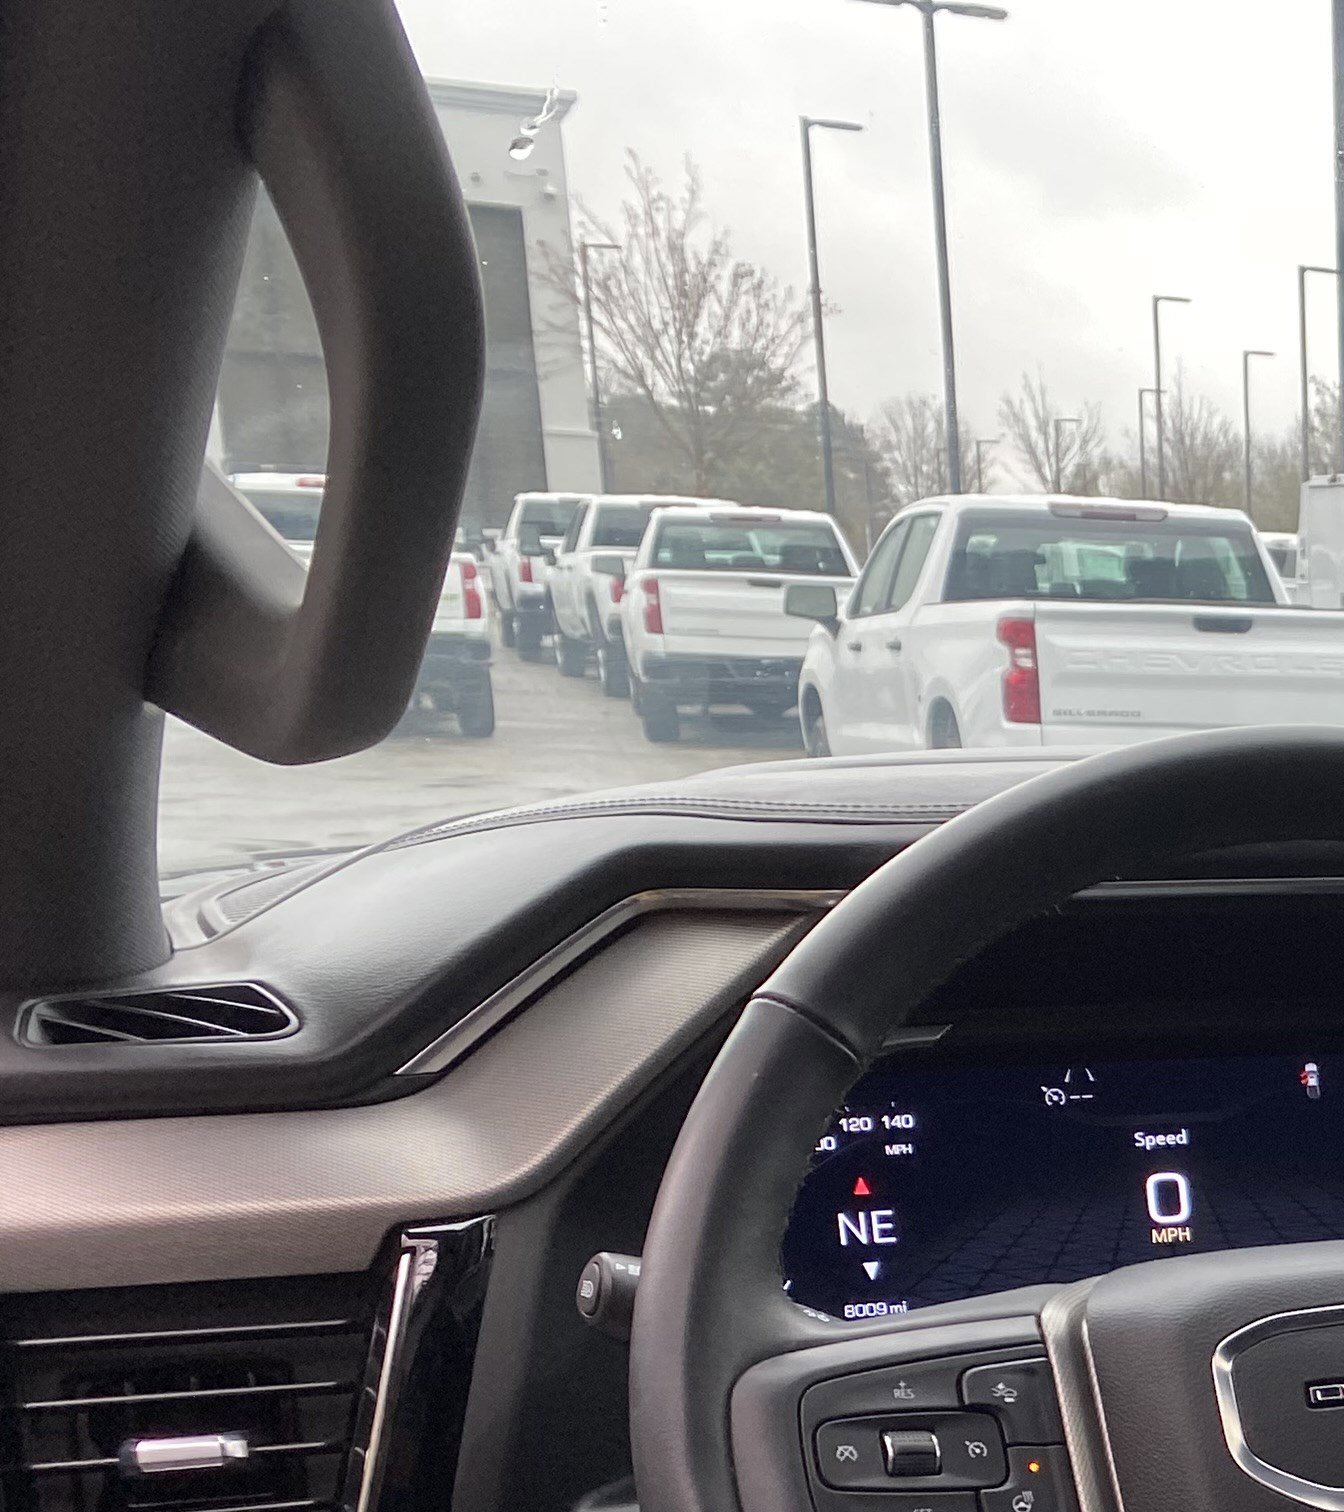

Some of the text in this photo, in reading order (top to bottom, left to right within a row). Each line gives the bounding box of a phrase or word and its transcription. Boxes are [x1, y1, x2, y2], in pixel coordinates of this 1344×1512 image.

[838, 1116, 872, 1132] 120
[881, 1113, 914, 1129] 140
[1133, 1128, 1188, 1151] Speed
[884, 1143, 913, 1156] MPH
[1145, 1171, 1191, 1224] 0
[837, 1208, 898, 1246] NE
[1151, 1226, 1191, 1244] MPH
[844, 1302, 888, 1319] 8009
[889, 1300, 908, 1315] mi
[893, 1388, 915, 1400] RES
